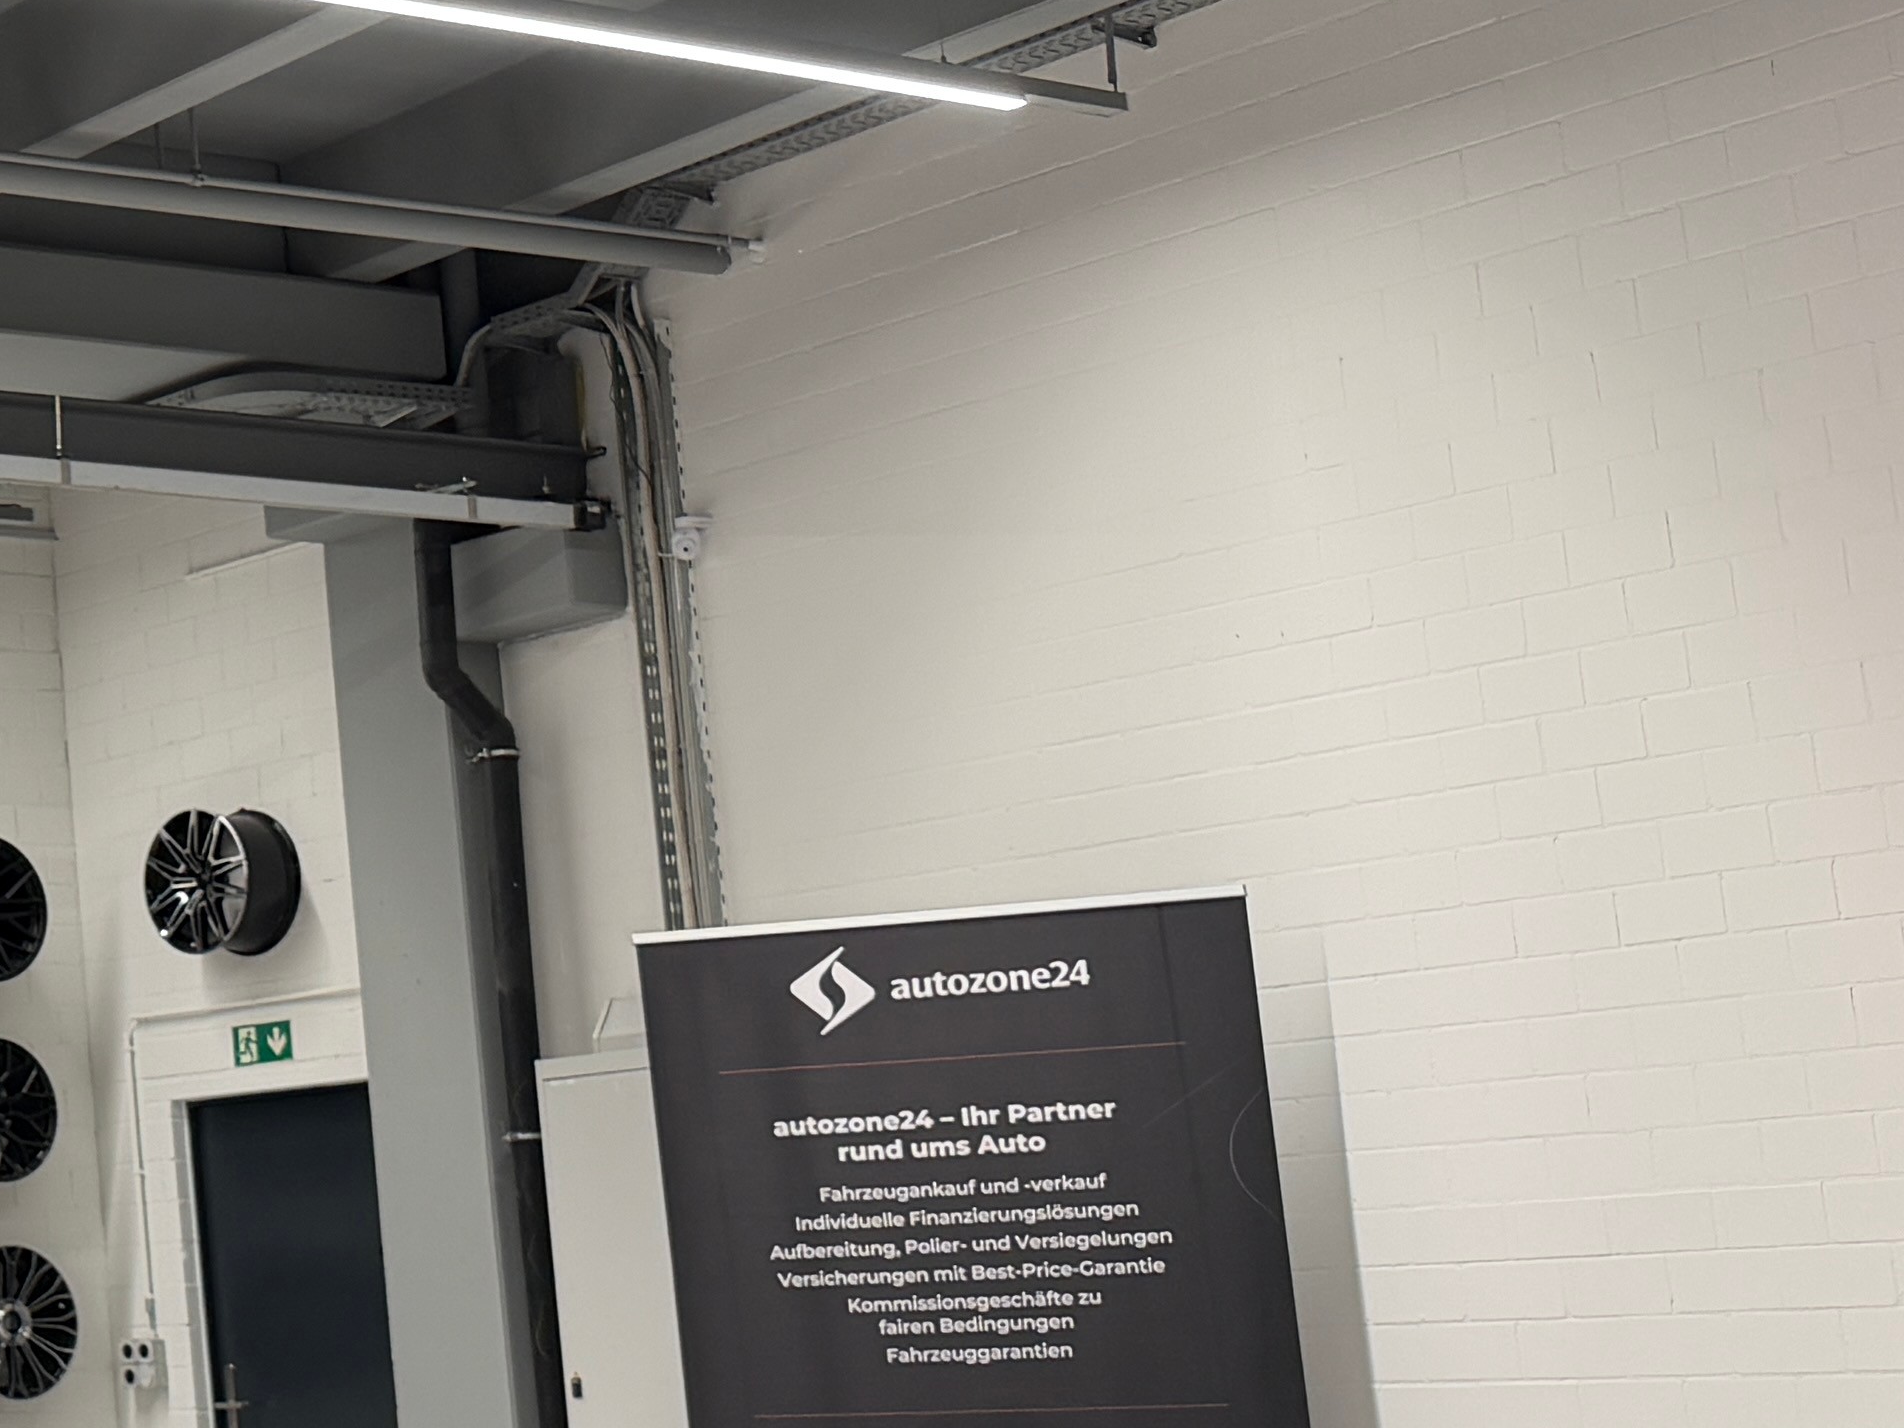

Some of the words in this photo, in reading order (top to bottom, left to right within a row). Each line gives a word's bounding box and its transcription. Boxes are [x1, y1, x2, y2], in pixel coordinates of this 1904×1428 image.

[890, 959, 1091, 1000] autozone24
[773, 1109, 935, 1137] autozone24
[960, 1105, 1001, 1127] Ihr
[1007, 1102, 1117, 1124] Partner
[837, 1138, 904, 1162] rund
[910, 1139, 972, 1159] ums
[977, 1133, 1047, 1155] Auto
[819, 1178, 977, 1203] Fahrzeugankauf
[980, 1176, 1020, 1195] und
[795, 1211, 906, 1232] Individuelle
[909, 1203, 1140, 1226] Finanzierungslösungen
[971, 1234, 1011, 1252] und
[1014, 1230, 1173, 1251] Versiegelungen
[776, 1269, 930, 1288] Versicherungen
[933, 1264, 968, 1282] mit
[847, 1289, 1074, 1314] Kommissionsgeschäfte
[1077, 1291, 1102, 1306] zu
[878, 1318, 936, 1336] fairen
[939, 1314, 1075, 1335] Bedingungen
[886, 1341, 1073, 1365] Fahrzeuggarantien
